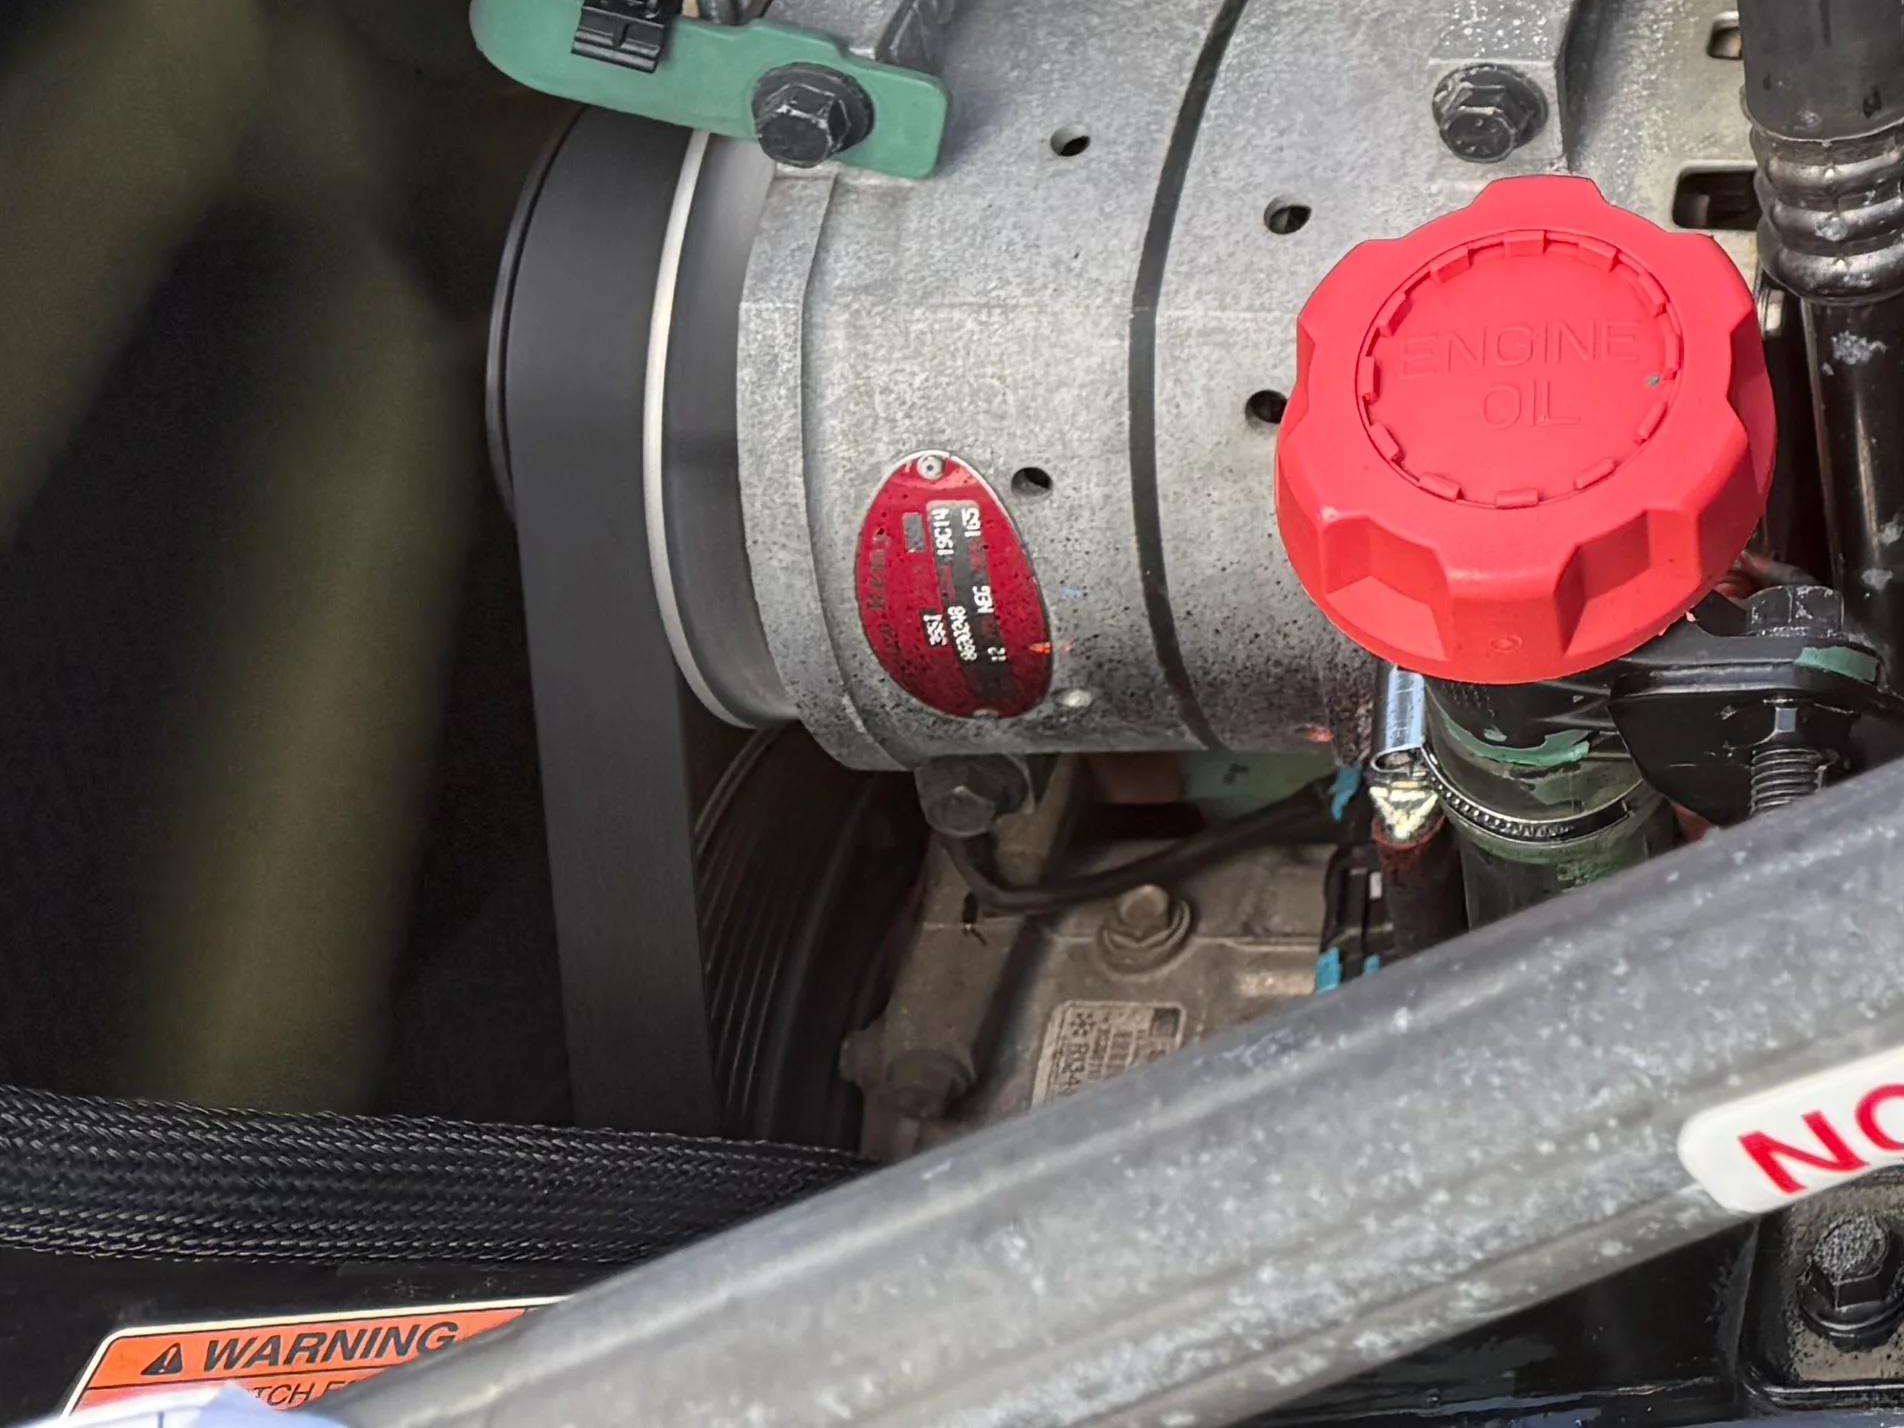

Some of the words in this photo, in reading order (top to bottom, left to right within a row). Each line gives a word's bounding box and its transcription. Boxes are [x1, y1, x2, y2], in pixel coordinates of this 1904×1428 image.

[1399, 320, 1641, 379] ENGINE
[1483, 379, 1581, 429] OIL
[203, 1322, 459, 1372] WARNING
[254, 1381, 316, 1407] TCH
